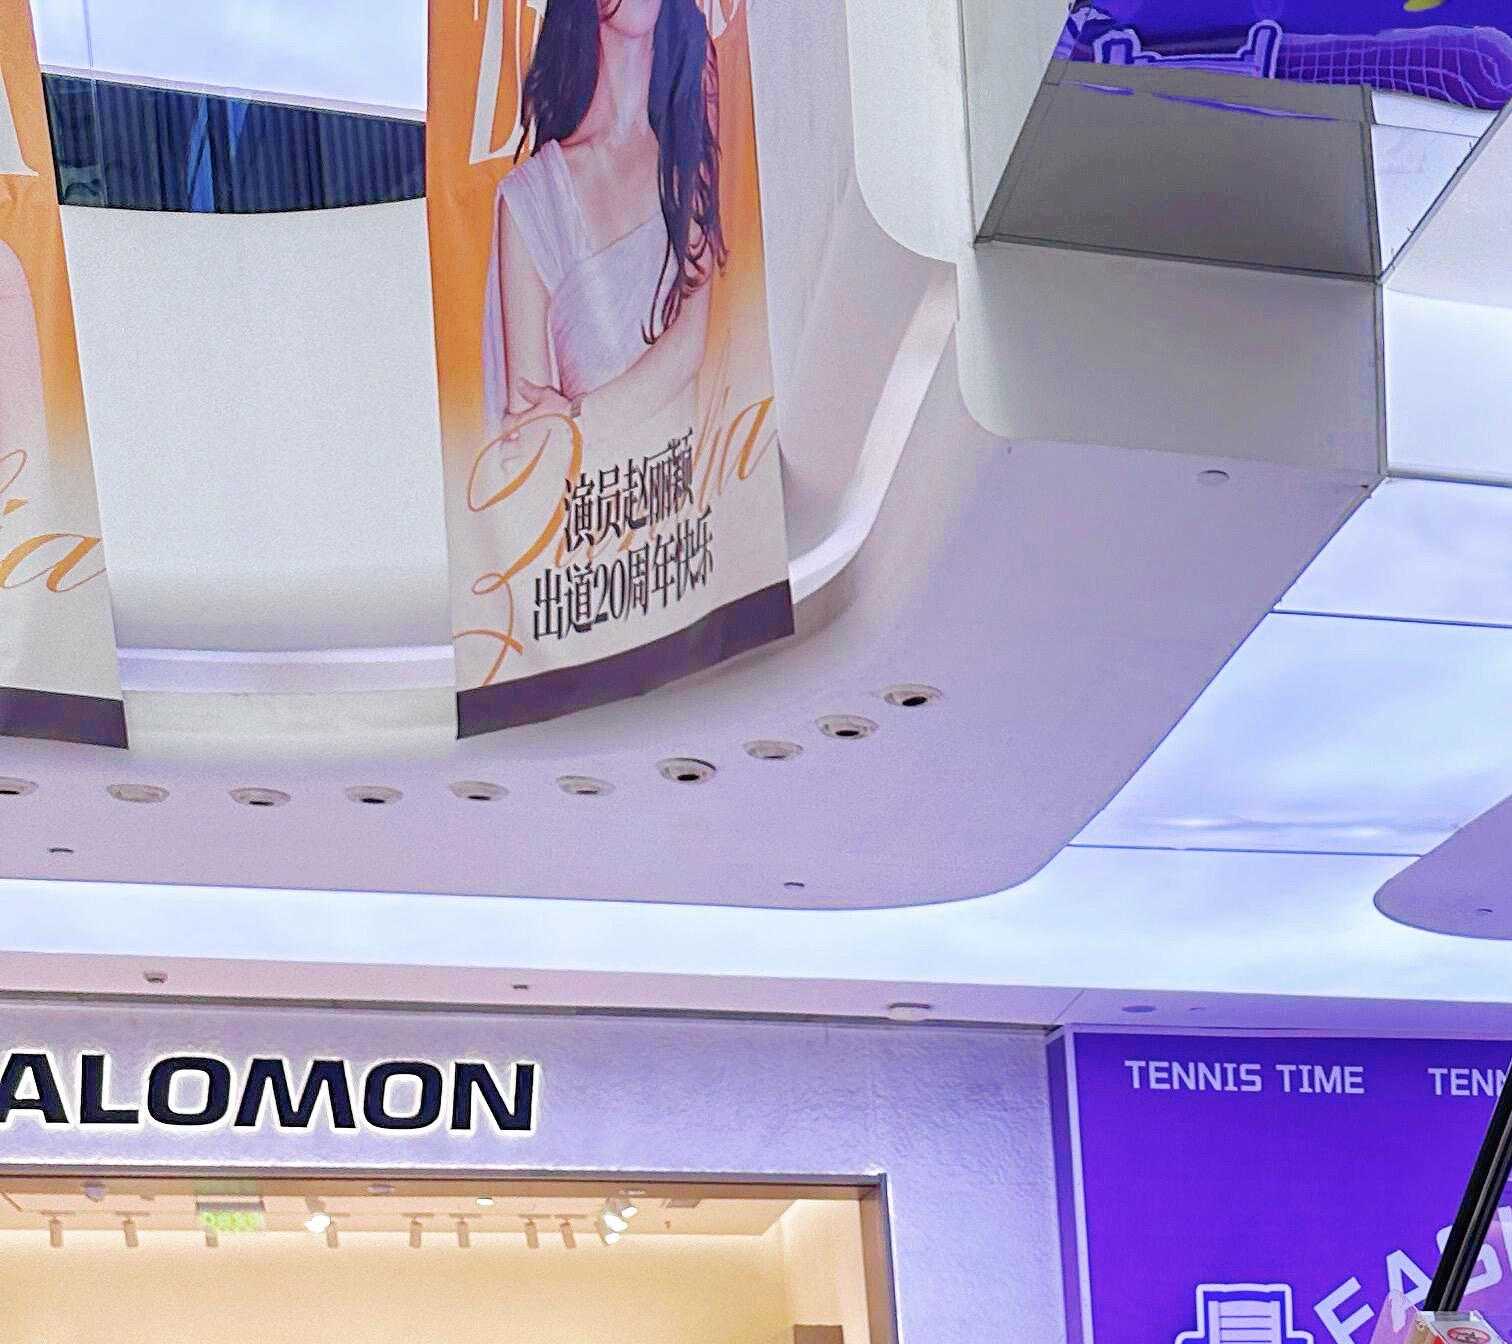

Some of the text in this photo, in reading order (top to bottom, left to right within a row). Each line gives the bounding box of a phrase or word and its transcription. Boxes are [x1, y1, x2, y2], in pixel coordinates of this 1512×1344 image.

[565, 427, 693, 552] 演员赵丽颖
[534, 504, 714, 640] 出道20周年快乐
[1124, 1060, 1365, 1094] TENNIS TIME
